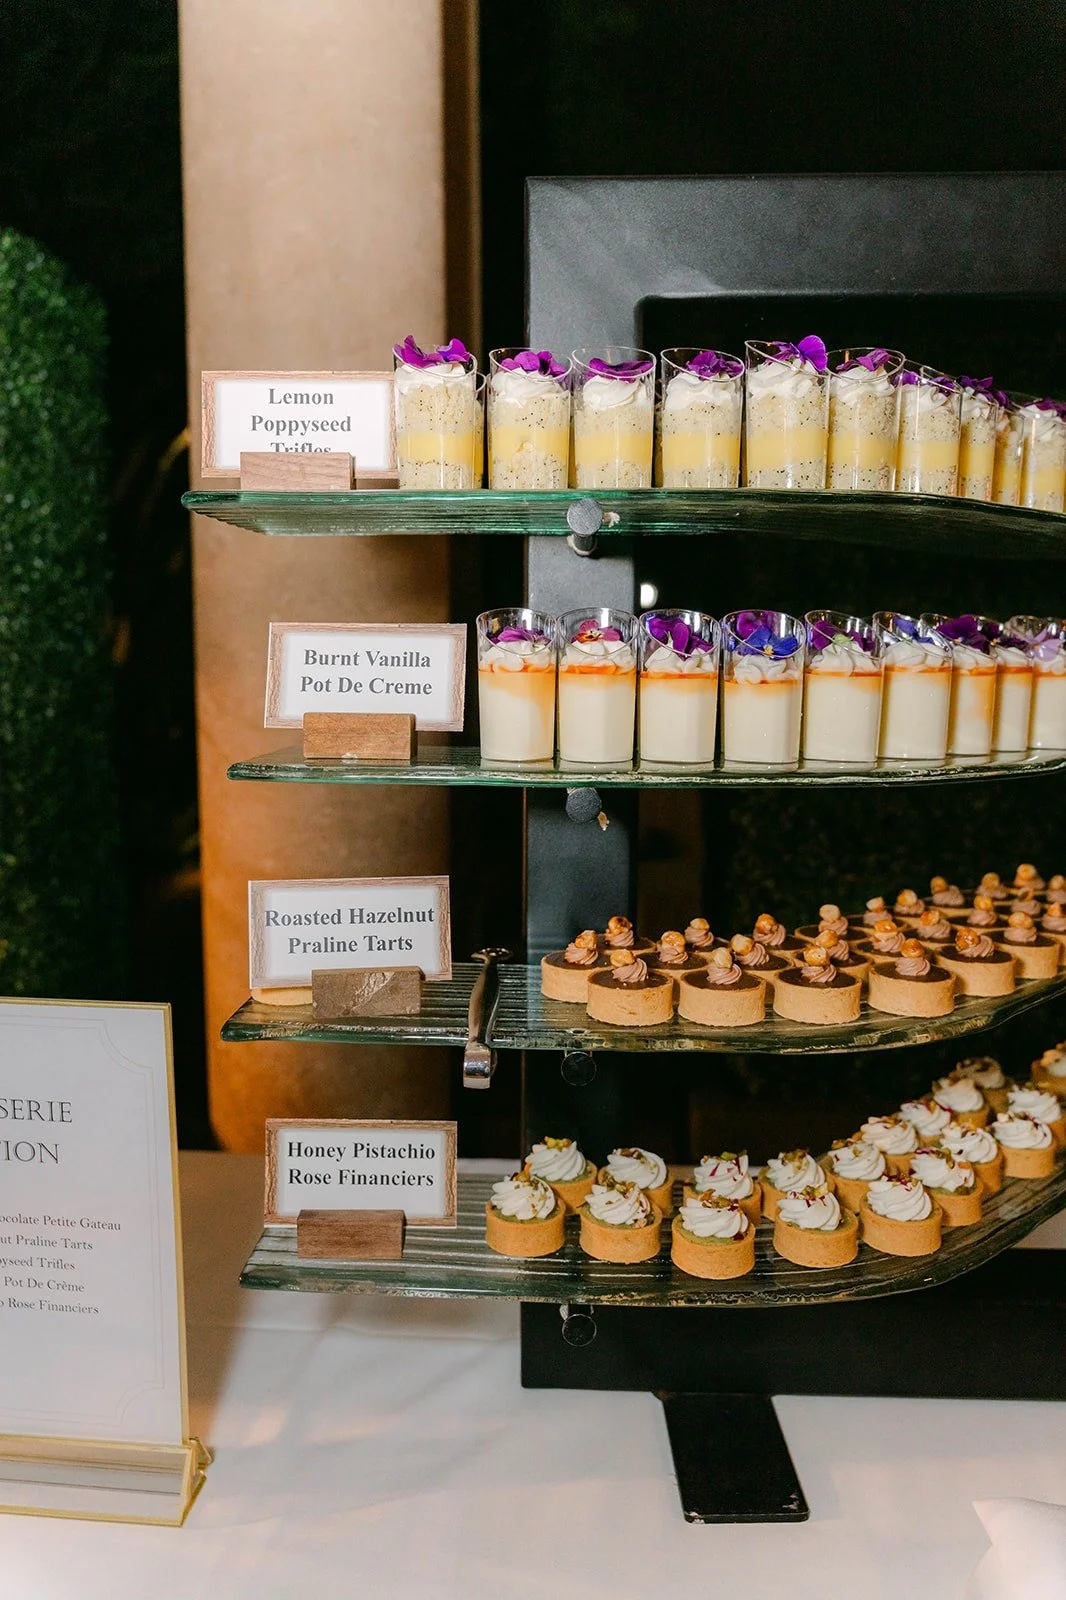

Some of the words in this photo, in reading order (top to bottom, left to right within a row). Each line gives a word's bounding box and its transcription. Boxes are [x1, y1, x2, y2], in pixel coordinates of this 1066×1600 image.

[269, 388, 334, 405] Lemon
[251, 415, 352, 436] Poppyseed
[304, 649, 360, 666] Burnt
[365, 650, 431, 668] Vanilla
[300, 676, 332, 693] Pot
[338, 677, 363, 693] De
[369, 677, 433, 695] Creme
[265, 908, 342, 927] Roasted
[349, 907, 435, 925] Hazelnut
[288, 936, 358, 954] Praline
[363, 935, 413, 952] Tarts
[0, 1098, 73, 1123] SERIE
[0, 1140, 59, 1164] ION
[288, 1141, 346, 1162] Honey
[353, 1142, 436, 1160] Pistachio
[289, 1168, 332, 1185] Rose
[338, 1169, 434, 1187] Financiers
[43, 1215, 77, 1228] Petite
[79, 1217, 121, 1231] Gateau
[16, 1234, 58, 1248] Praline
[61, 1237, 94, 1250] Tarts
[0, 1256, 33, 1269] yseed
[36, 1256, 76, 1270] Trifles
[4, 1276, 23, 1288] Pot
[27, 1277, 44, 1289] De
[47, 1279, 85, 1293] Crème
[8, 1297, 36, 1309] Rose
[39, 1299, 100, 1314] Financiers
